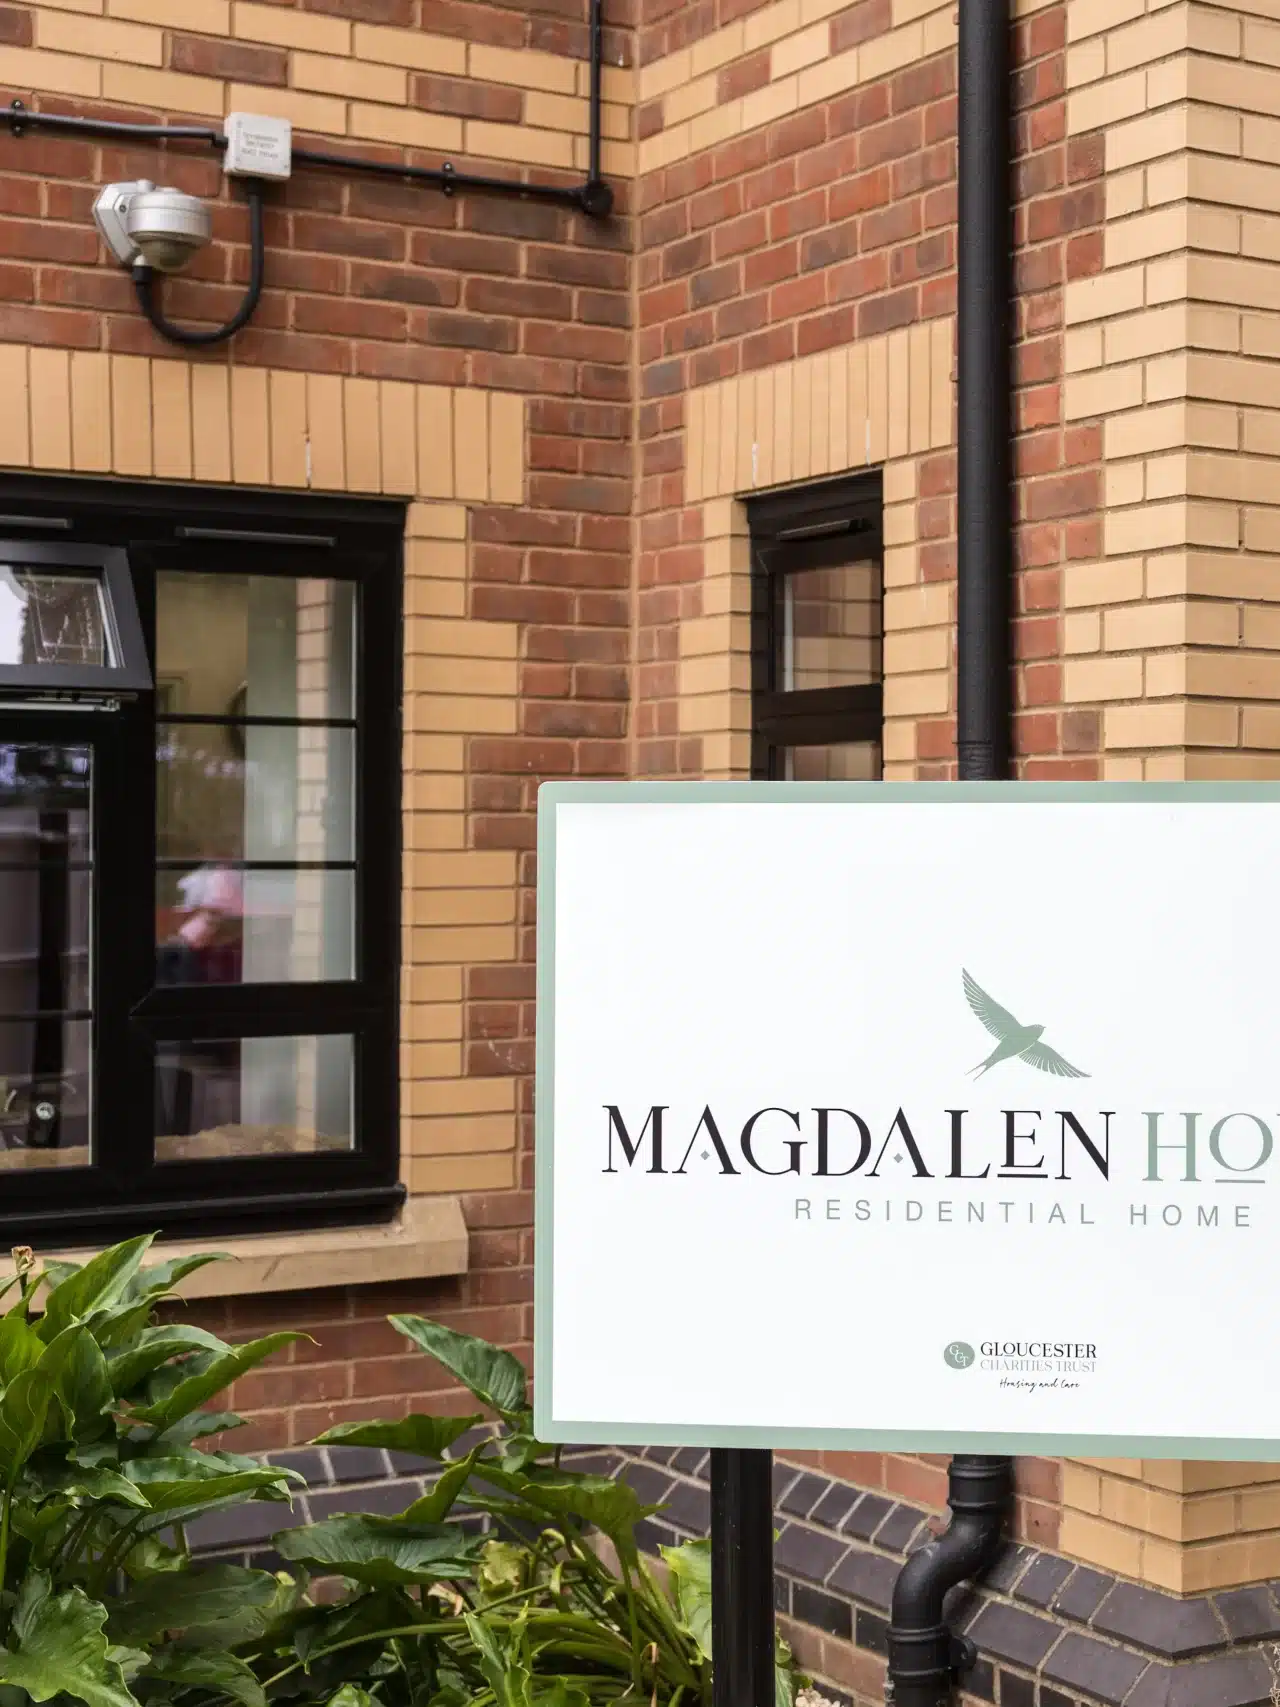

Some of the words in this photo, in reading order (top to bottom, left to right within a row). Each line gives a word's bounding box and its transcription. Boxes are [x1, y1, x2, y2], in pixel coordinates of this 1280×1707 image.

[601, 1103, 1117, 1182] MAGDALEN
[795, 1198, 1095, 1225] RESIDENTIAL
[1129, 1203, 1251, 1228] HOME
[980, 1341, 1098, 1359] GLOUCESTER
[980, 1359, 1053, 1372] CHARITIES
[1055, 1360, 1097, 1373] TRUST
[999, 1376, 1037, 1394] Housing
[1038, 1378, 1058, 1389] and
